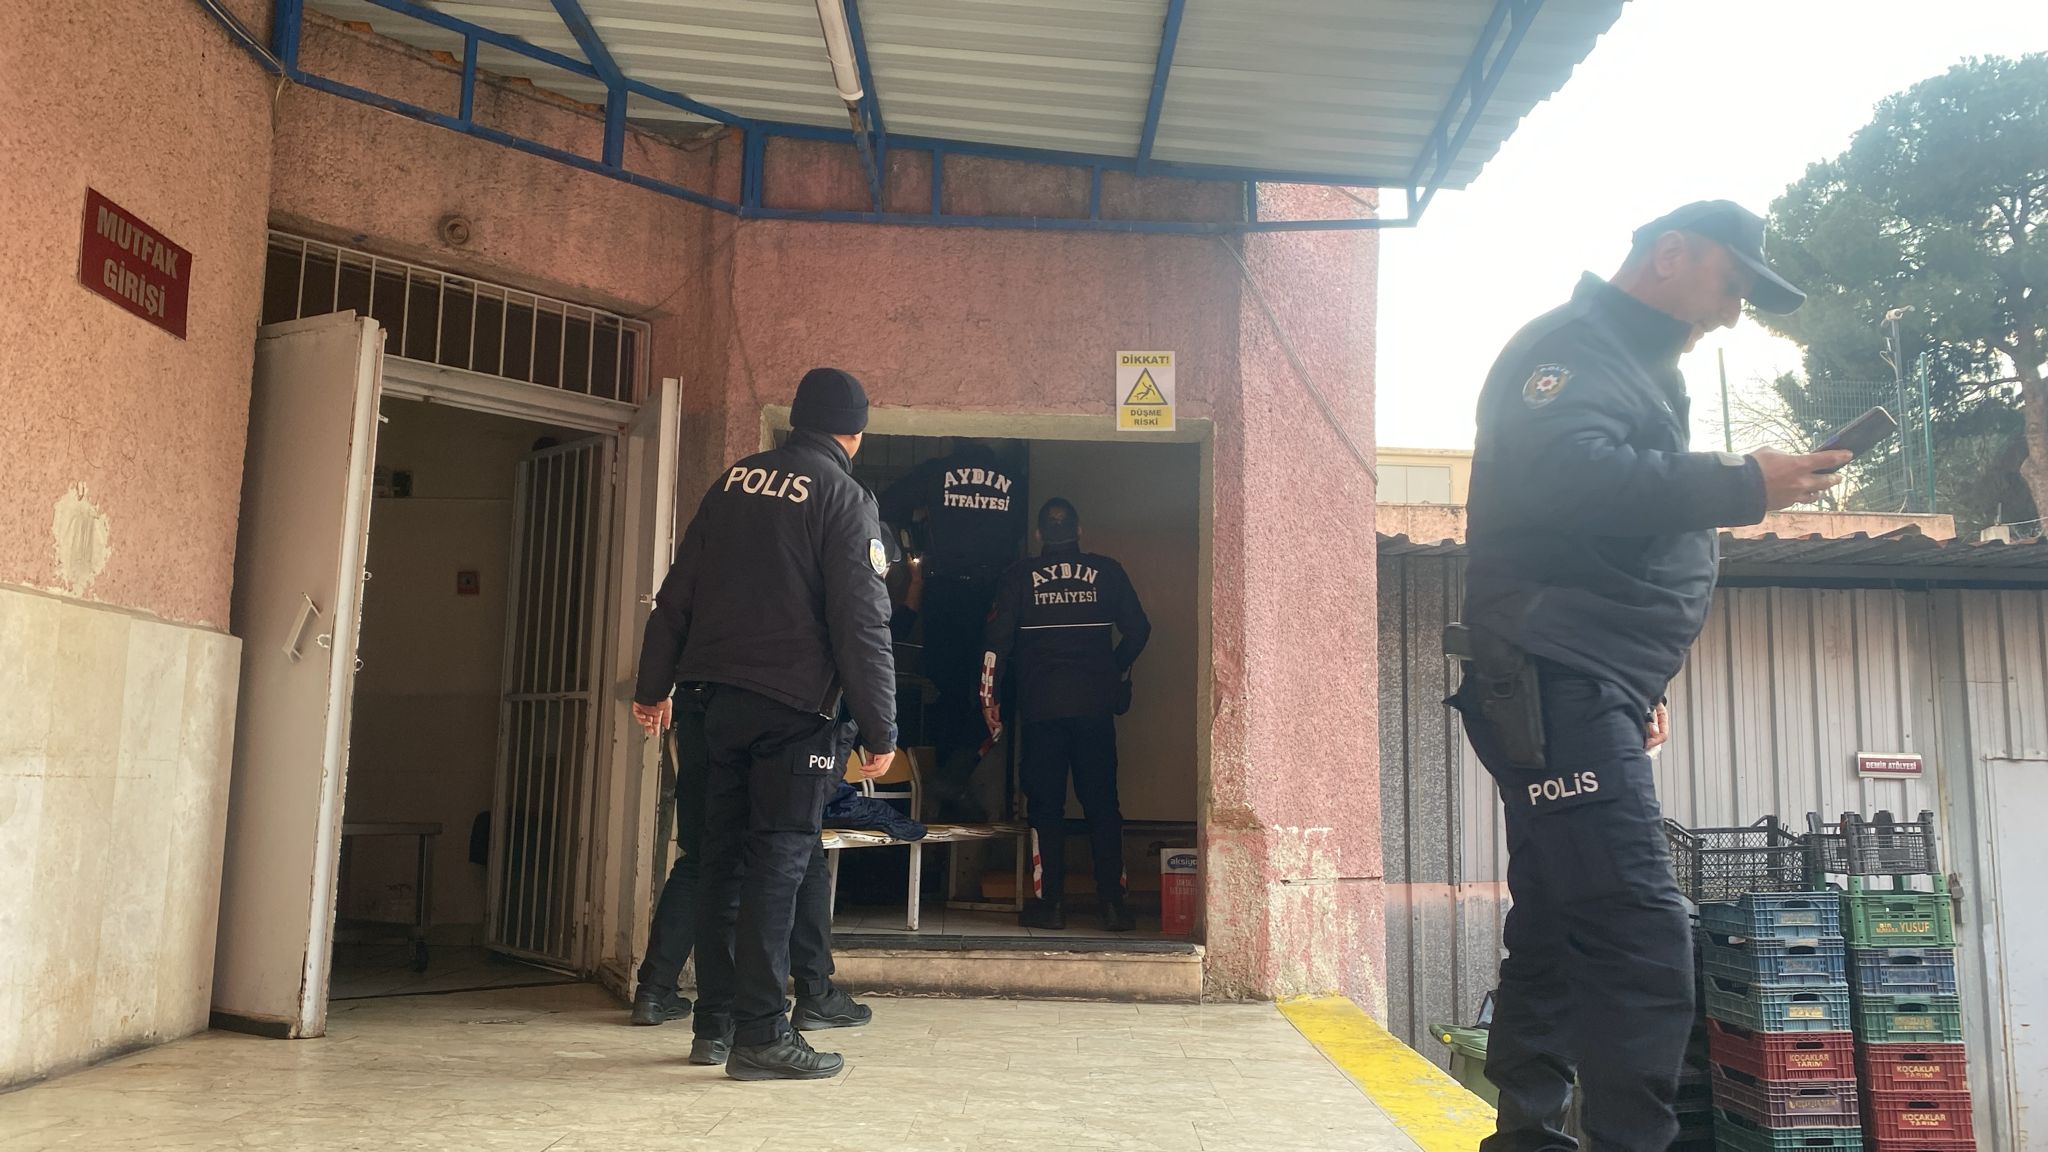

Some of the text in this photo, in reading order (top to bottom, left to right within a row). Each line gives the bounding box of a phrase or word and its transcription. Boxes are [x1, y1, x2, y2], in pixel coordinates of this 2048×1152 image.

[96, 205, 179, 279] MUTFAK
[103, 258, 166, 318] GİRİŞİ
[1122, 354, 1169, 365] DİKKAT!
[1130, 408, 1162, 417] DÜŞME
[1134, 418, 1158, 426] RİSKİ
[723, 466, 812, 503] POLİS
[944, 468, 1012, 493] AYDIN
[944, 491, 1010, 511] İTFAİYESİ
[1032, 563, 1098, 587] AYDIN
[1034, 587, 1097, 605] İTFAİYESİ
[1865, 761, 1917, 770] DEMİR ATÖLYESİ
[1527, 771, 1599, 806] POLİS
[1899, 921, 1930, 933] YUSUF
